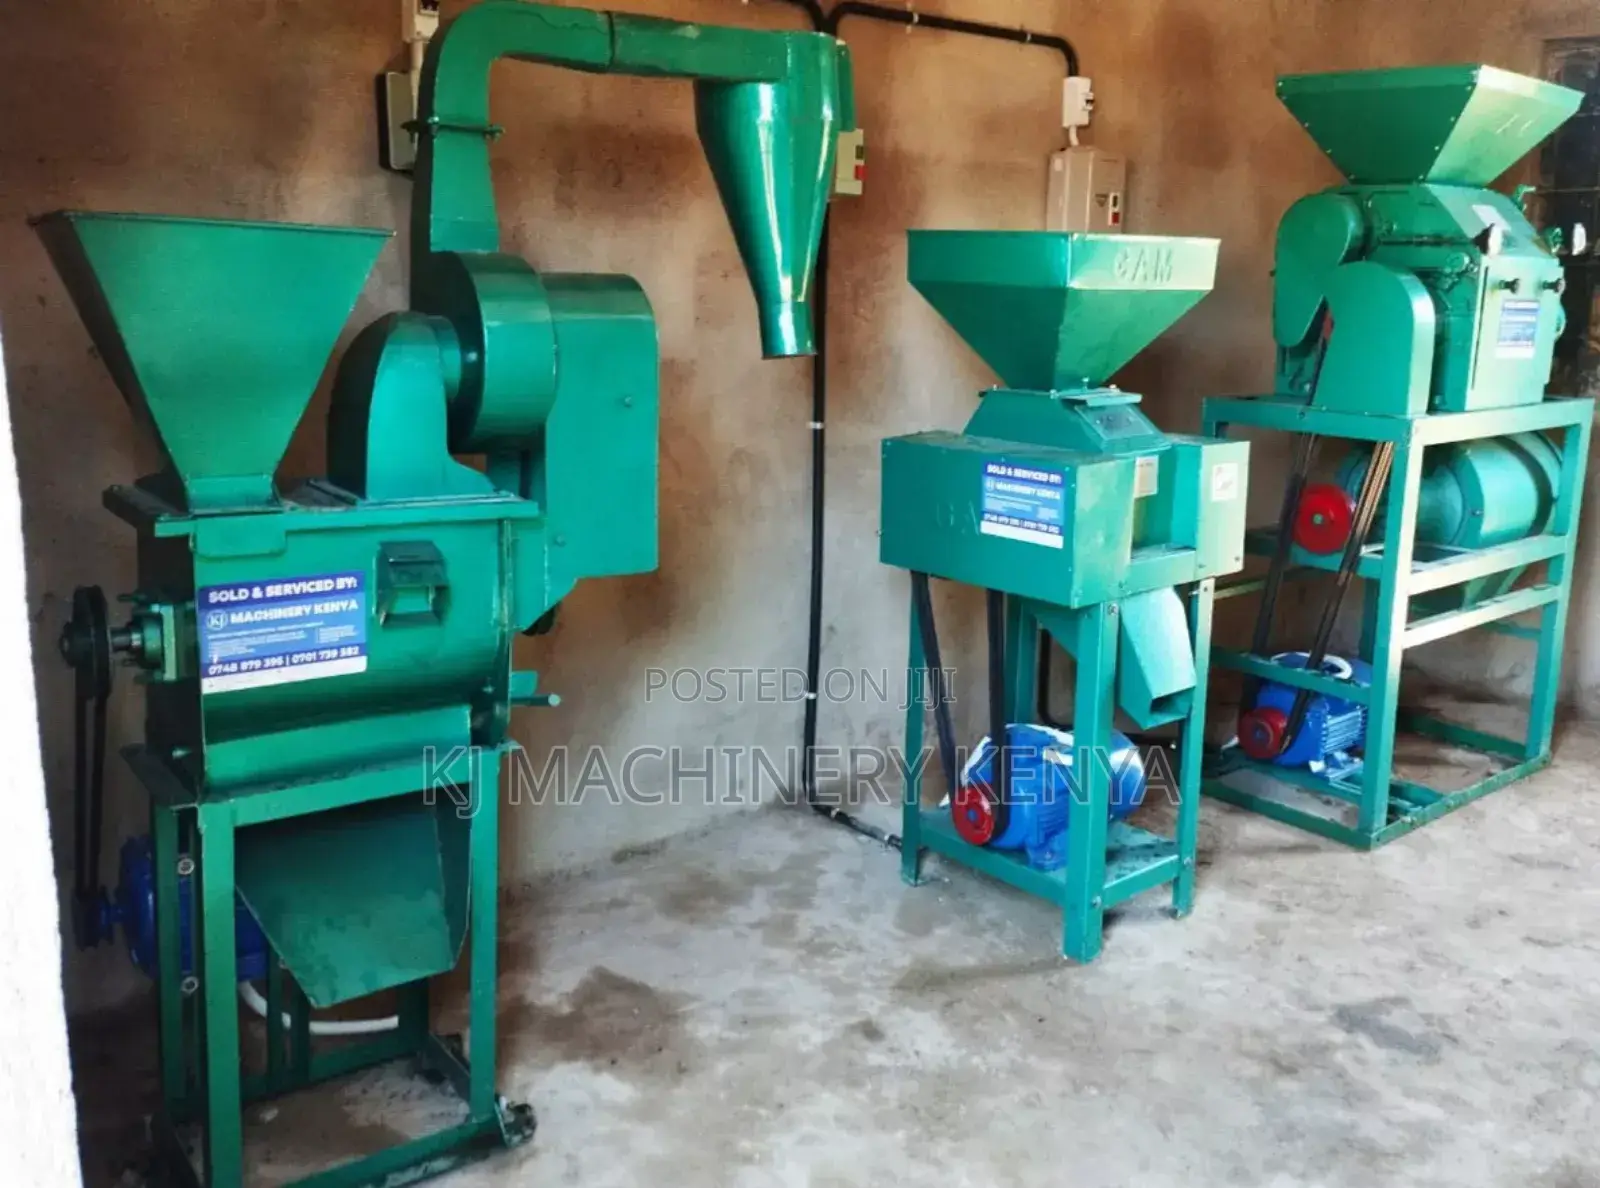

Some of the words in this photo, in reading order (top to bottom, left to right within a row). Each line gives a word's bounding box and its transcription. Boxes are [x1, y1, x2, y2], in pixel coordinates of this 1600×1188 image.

[208, 588, 249, 603] SOLD
[252, 586, 263, 599] &
[265, 579, 334, 598] SERVICED
[336, 576, 358, 590] BY:
[230, 604, 313, 625] MACHINERY
[314, 599, 358, 615] KENYA
